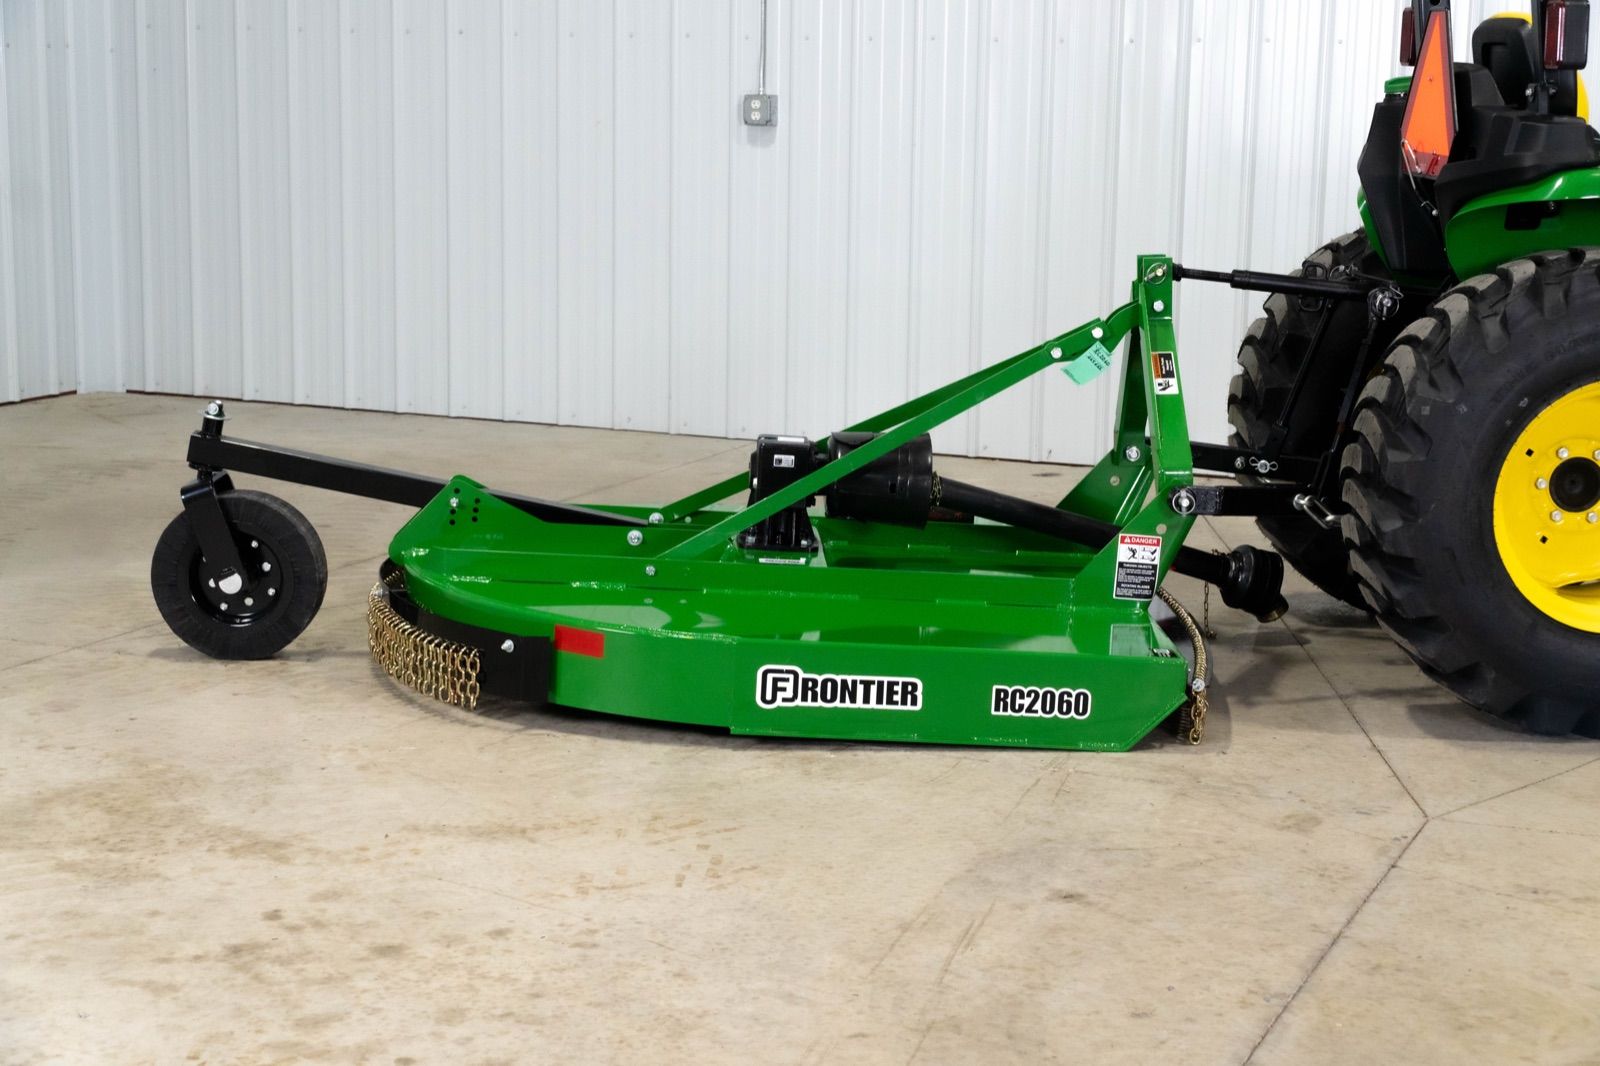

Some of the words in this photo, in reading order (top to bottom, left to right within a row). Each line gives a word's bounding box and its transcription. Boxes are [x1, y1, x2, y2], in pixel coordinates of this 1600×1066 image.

[1131, 537, 1157, 545] DANGER
[759, 667, 919, 707] FRONTIER
[993, 687, 1090, 717] RC2060
